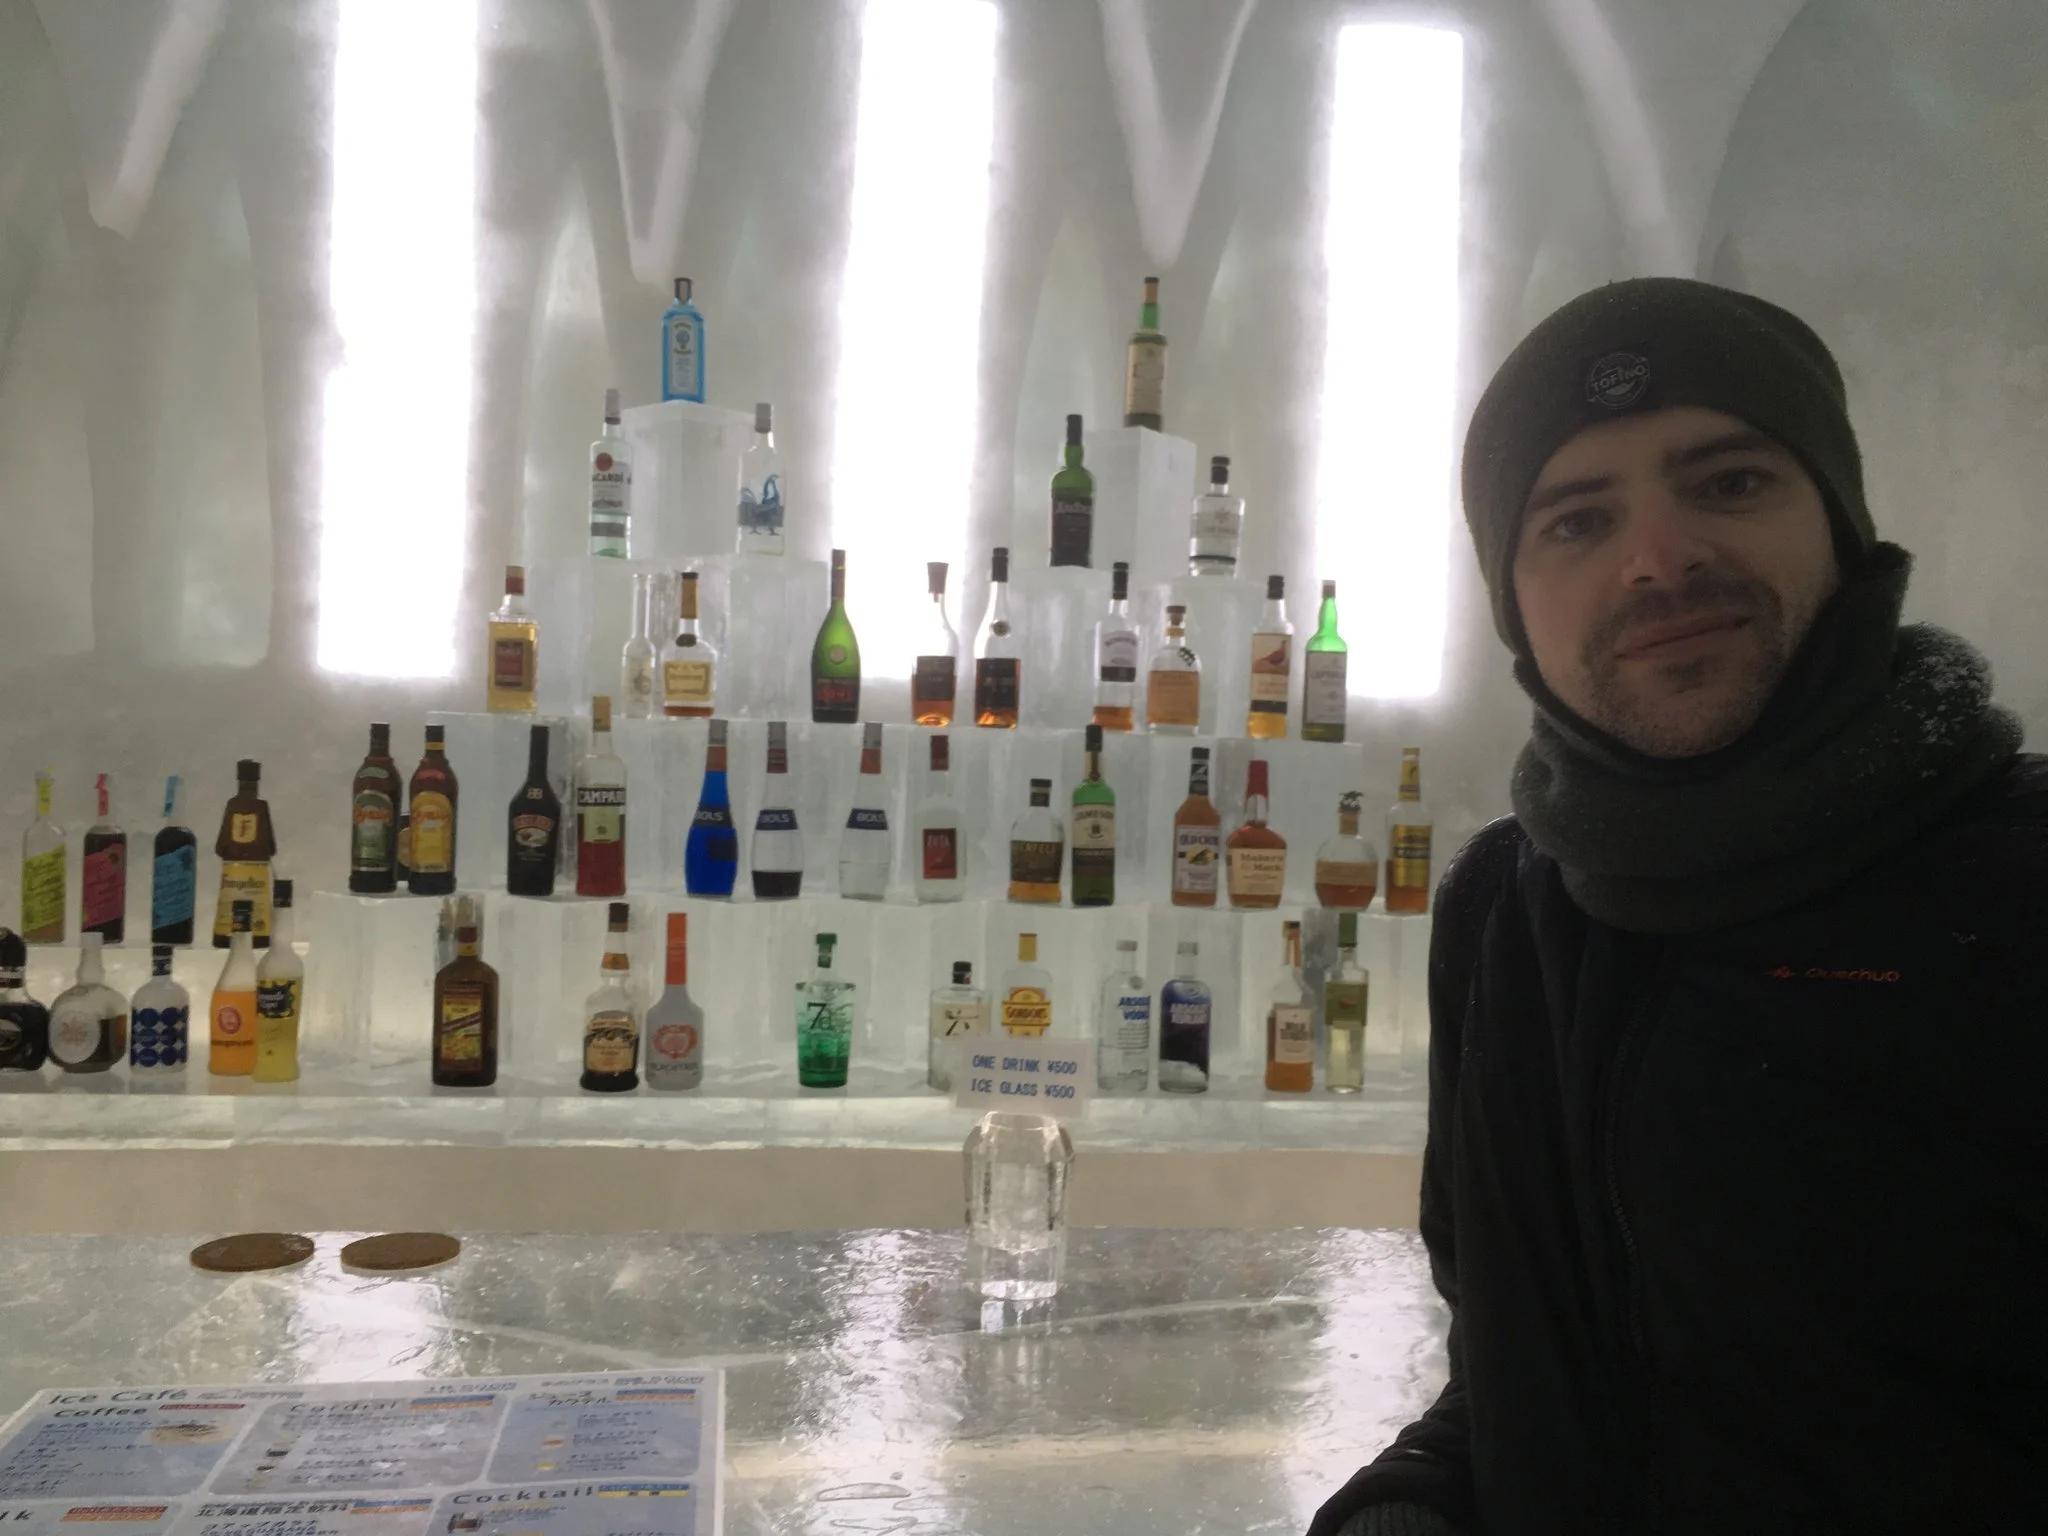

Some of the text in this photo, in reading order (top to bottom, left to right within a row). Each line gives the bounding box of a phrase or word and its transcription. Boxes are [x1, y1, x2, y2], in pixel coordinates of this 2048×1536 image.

[1591, 364, 1647, 392] TOFINO
[972, 1055, 1077, 1075] ONE DRINK ¥500
[971, 1078, 1075, 1099] ICE GLASS ¥500
[49, 1394, 98, 1404] Ice
[110, 1389, 189, 1402] Café
[54, 1407, 149, 1418] Coffee
[290, 1400, 399, 1413] Cordial
[452, 1486, 594, 1504] Cocktail
